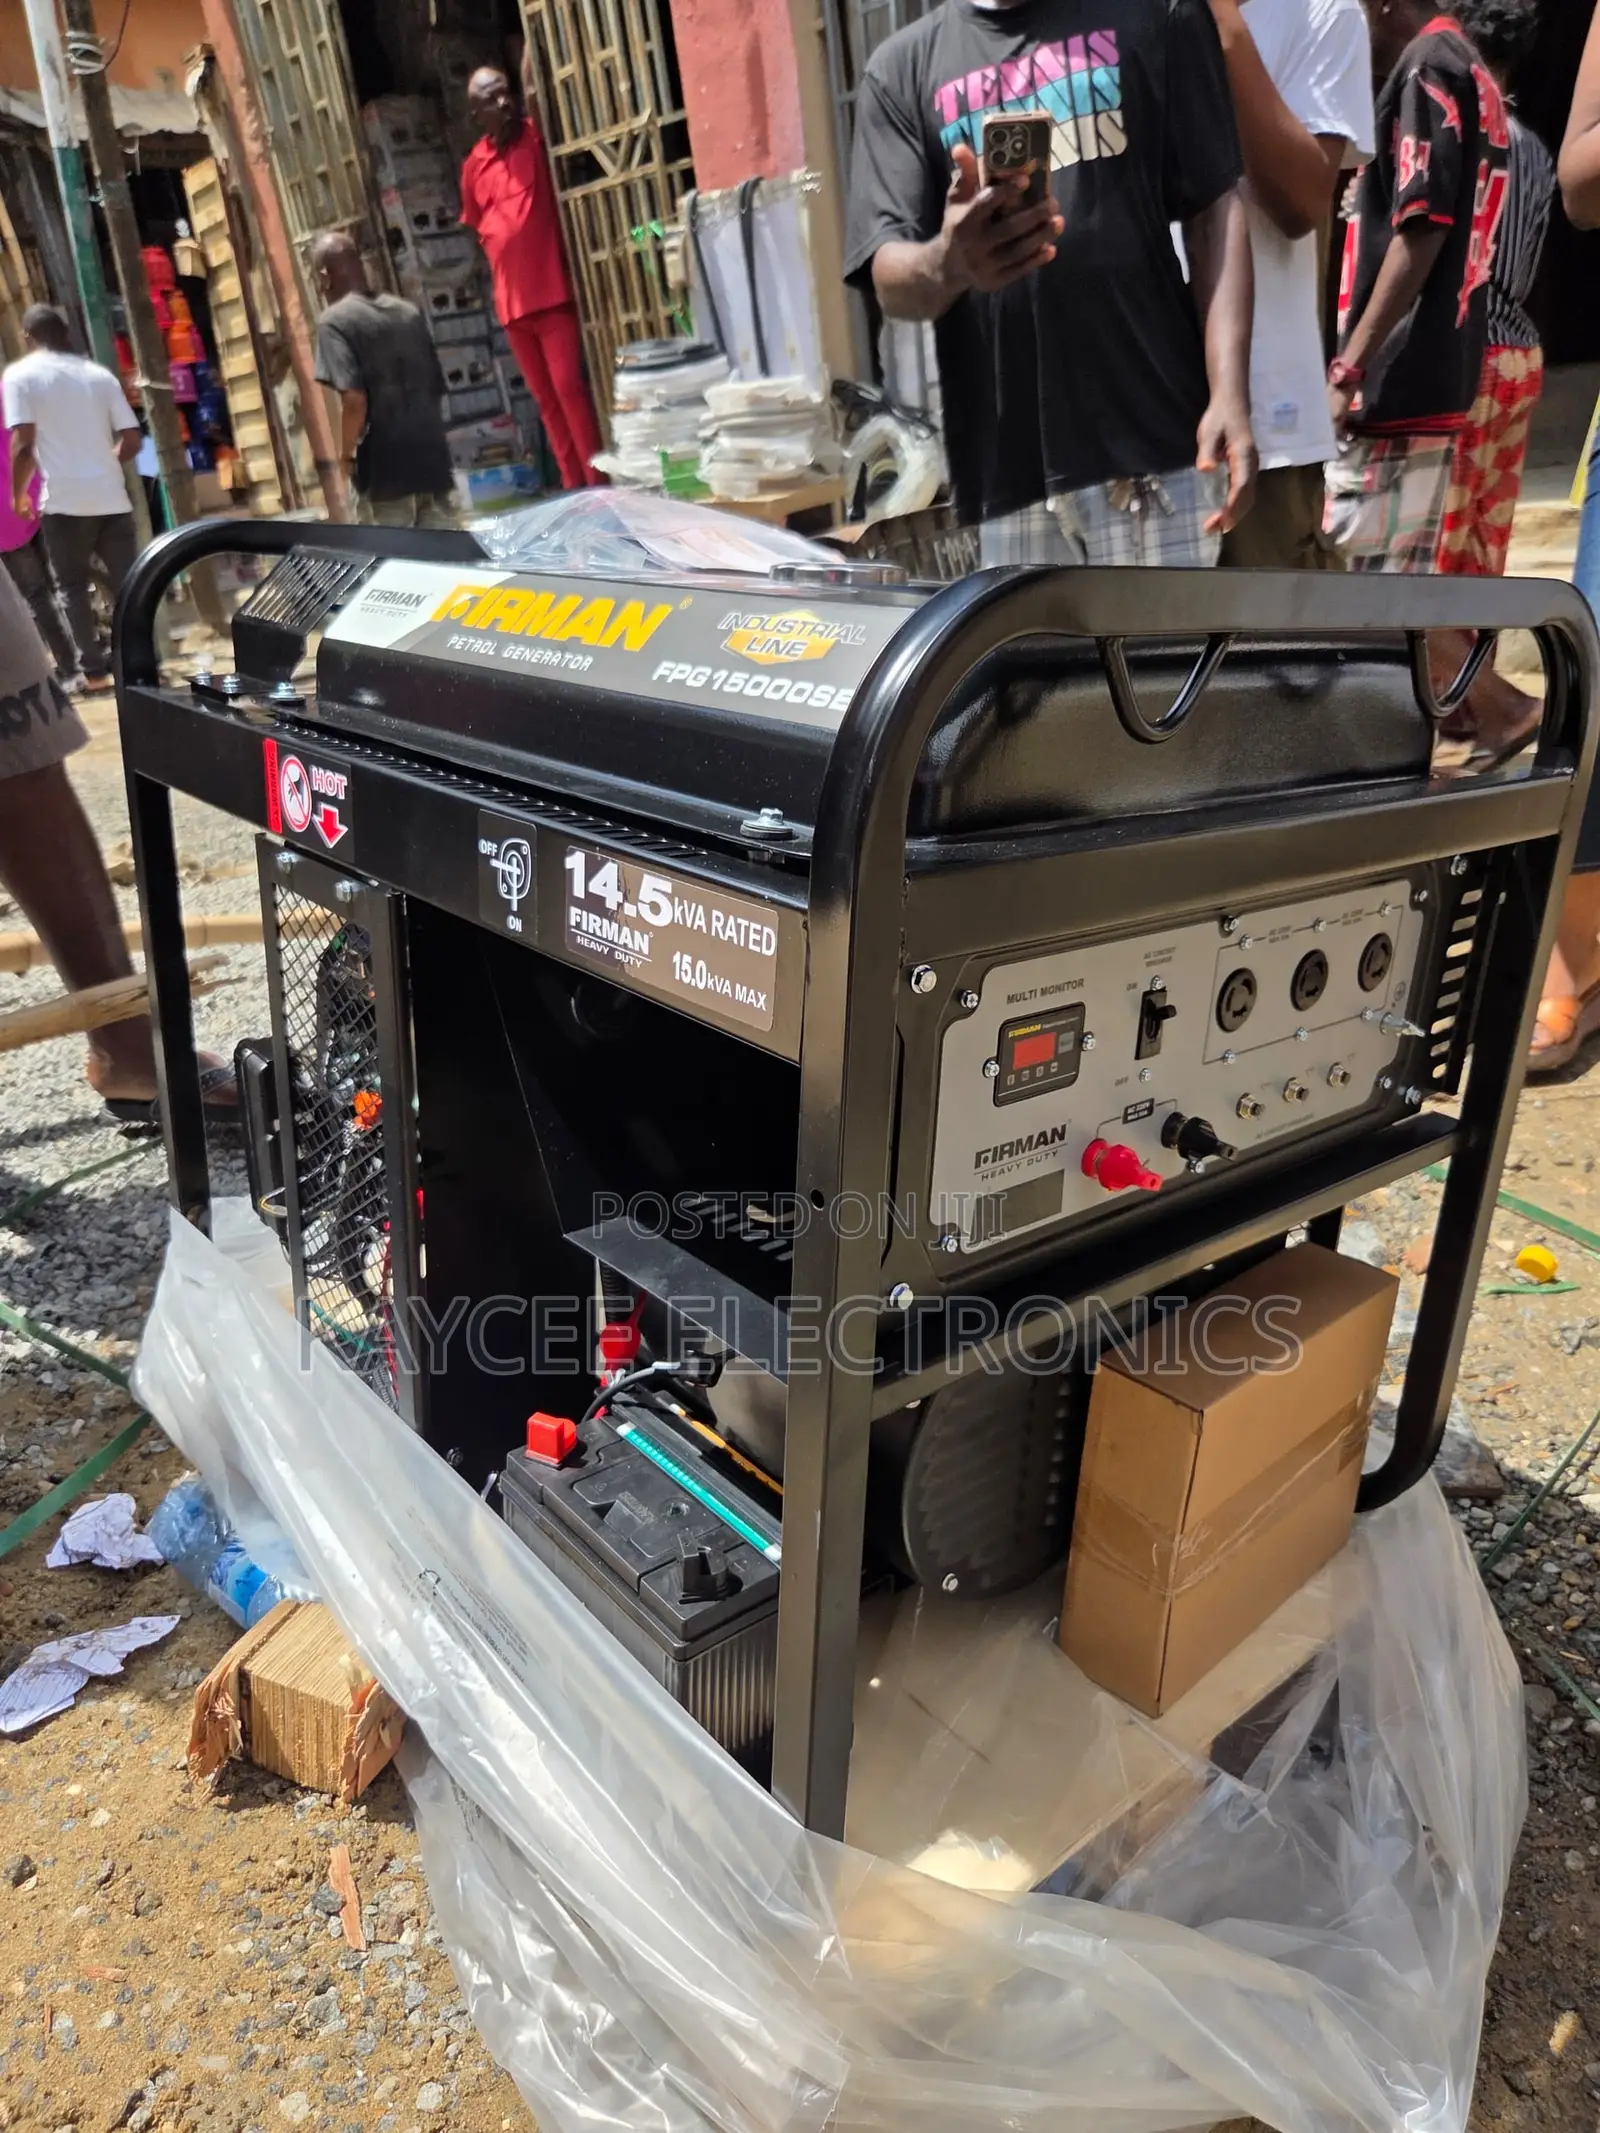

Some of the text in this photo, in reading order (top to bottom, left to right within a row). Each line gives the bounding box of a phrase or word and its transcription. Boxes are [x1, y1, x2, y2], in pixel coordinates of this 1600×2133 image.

[934, 29, 1120, 126] TENNIS
[364, 589, 427, 608] FIRMAN
[430, 584, 673, 652] FIRMAN
[717, 611, 867, 646] INDUSTRIAL
[447, 634, 594, 672] PETROL GENERATOR
[743, 636, 809, 658] LINE
[310, 764, 348, 800] HOT
[479, 839, 498, 856] OFF
[507, 915, 523, 933] ON
[570, 907, 650, 955] FIRMAN
[711, 909, 776, 957] RATED
[577, 936, 643, 968] HEAVY DUTY
[735, 982, 767, 1012] MAX
[1006, 978, 1085, 1005] MULTI MONITOR
[974, 1123, 1067, 1169] FIRMAN
[981, 1150, 1058, 1181] HEAVY DUTY
